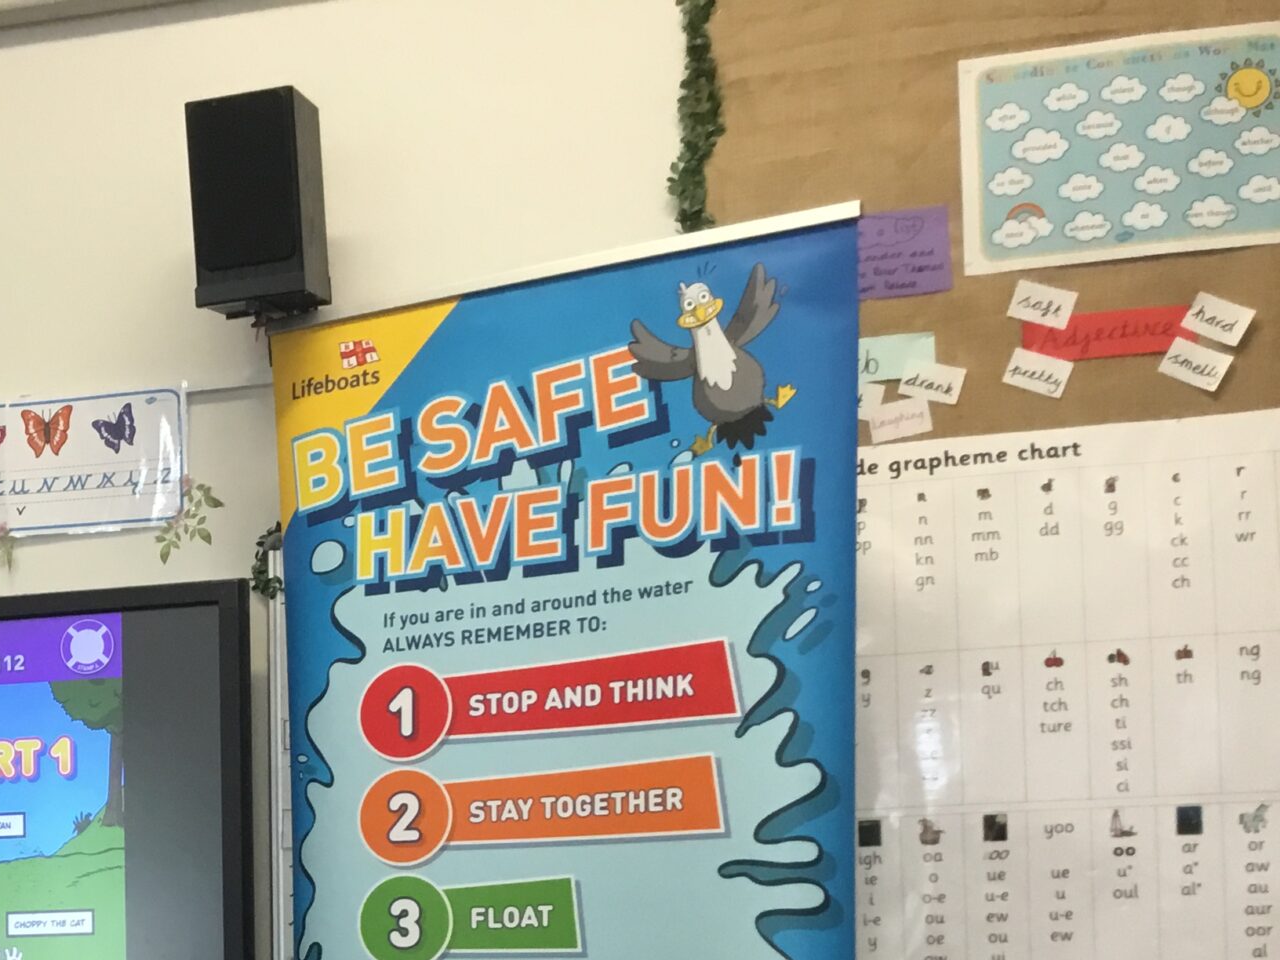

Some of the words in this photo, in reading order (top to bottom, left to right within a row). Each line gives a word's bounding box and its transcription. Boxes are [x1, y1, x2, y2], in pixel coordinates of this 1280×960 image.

[1018, 294, 1063, 319] soft
[1193, 307, 1238, 334] hard
[1008, 366, 1063, 393] pretty
[1167, 353, 1220, 382] smelly
[291, 367, 380, 401] Lifeboats
[905, 371, 953, 397] drank
[292, 412, 401, 513] BE
[418, 346, 651, 474] SAFE
[889, 451, 1007, 479] grapheme
[1017, 442, 1082, 461] chart
[356, 486, 563, 583] HAVE
[586, 449, 799, 555] FUN!
[383, 612, 397, 628] If
[399, 612, 429, 630] you
[434, 608, 465, 623] are
[470, 603, 486, 619] in
[492, 599, 525, 616] and
[531, 591, 597, 612] around
[602, 588, 633, 604] the
[637, 579, 693, 599] water
[382, 631, 456, 654] ALWAYS
[461, 620, 570, 645] REMEMBER
[576, 616, 608, 635] TO:
[1239, 644, 1261, 661] ng
[1045, 677, 1064, 691] ch
[1111, 674, 1128, 688] sh
[388, 686, 414, 738] 1
[468, 693, 538, 717] STOP
[544, 684, 602, 710] AND
[609, 672, 694, 705] THINK
[1043, 699, 1068, 712] tch
[1040, 719, 1072, 734] ture
[49, 735, 74, 777] 1
[387, 791, 421, 843] 2
[468, 798, 533, 824] STAY
[540, 787, 684, 819] TOGETHER
[1045, 822, 1074, 838] yoo
[14, 921, 47, 929] CHOPPY
[70, 919, 86, 927] CAT
[387, 896, 422, 949] 3
[470, 904, 553, 930] FLOAT
